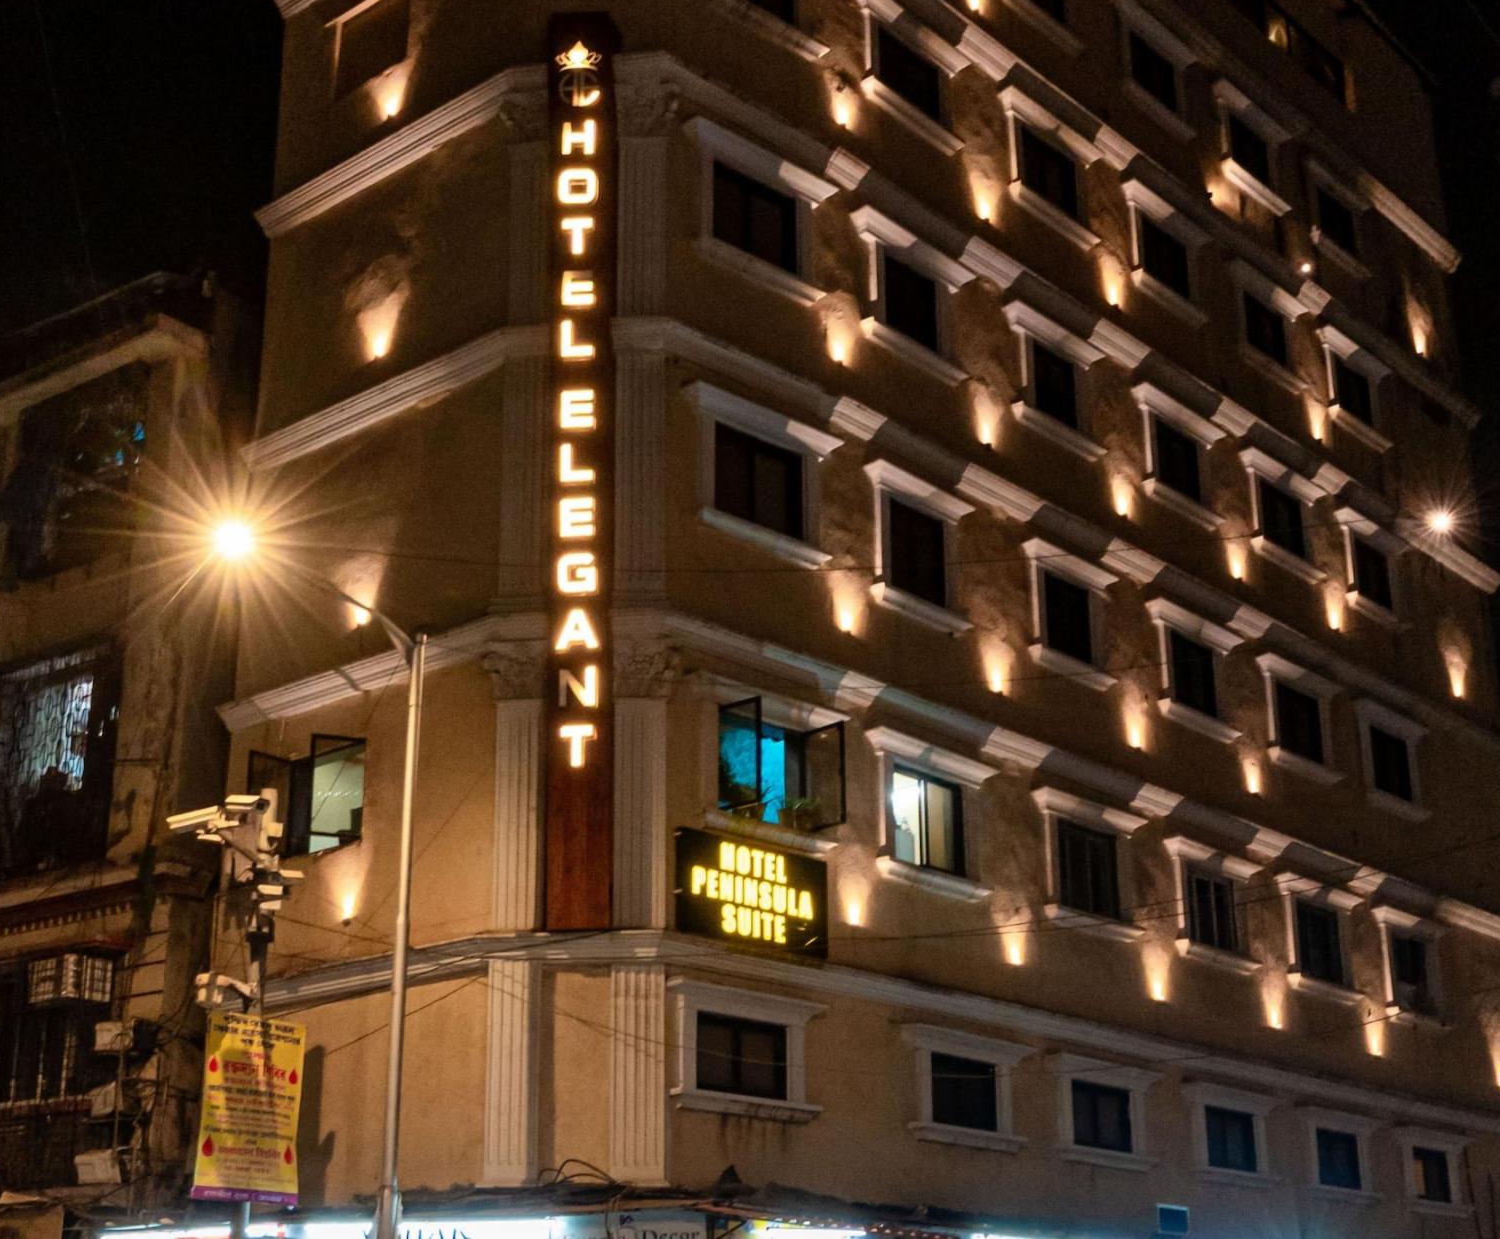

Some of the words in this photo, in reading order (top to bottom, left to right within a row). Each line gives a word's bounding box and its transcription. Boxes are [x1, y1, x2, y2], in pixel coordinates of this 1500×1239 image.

[557, 119, 600, 360] HOTEL
[556, 388, 601, 768] ELEGANT
[719, 841, 787, 884] HOTEL
[691, 865, 813, 920] PENINSULA
[721, 903, 787, 944] SUITE
